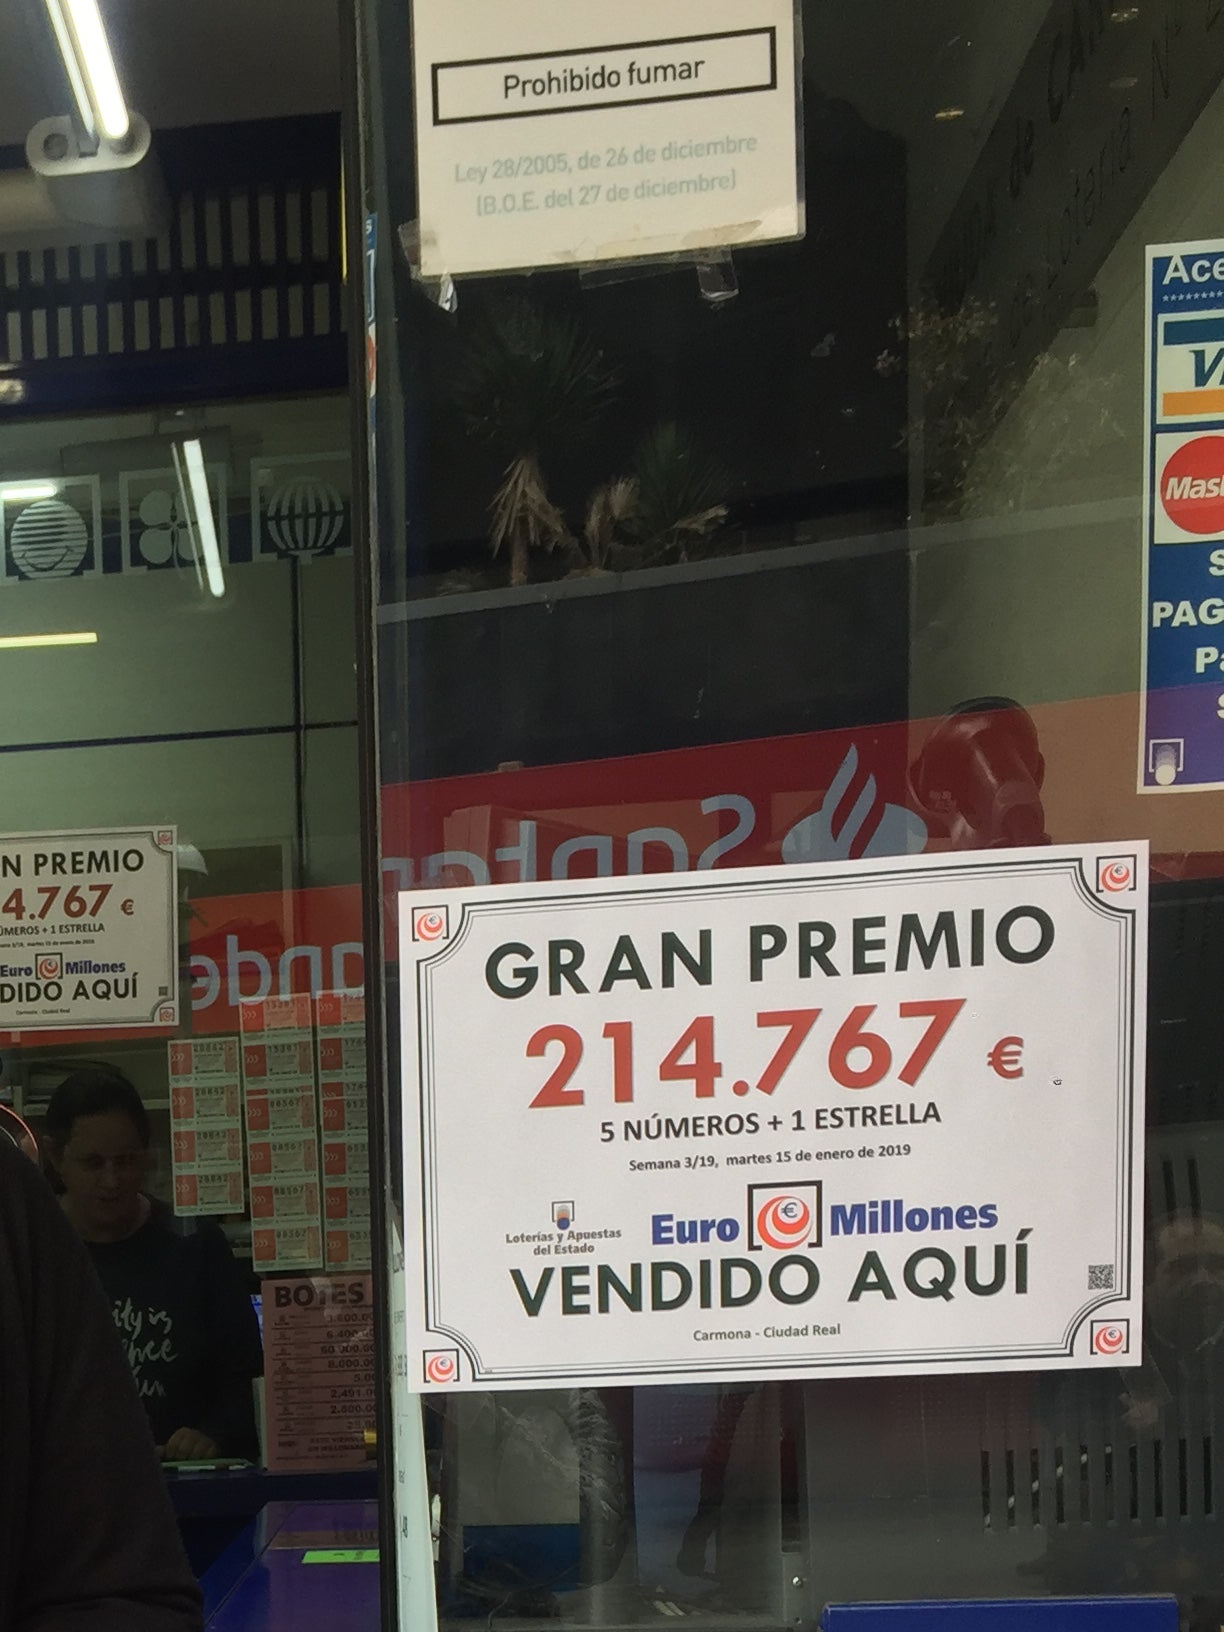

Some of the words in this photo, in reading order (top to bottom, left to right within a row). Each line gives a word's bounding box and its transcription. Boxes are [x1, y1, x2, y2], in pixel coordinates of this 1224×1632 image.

[504, 65, 620, 98] Prohibido
[628, 61, 705, 85] fumar
[454, 163, 486, 184] Ley
[492, 153, 572, 179] 28/2005,
[578, 150, 602, 171] de
[606, 147, 628, 167] 26
[634, 144, 655, 165] de
[661, 135, 758, 161] diciembre
[477, 193, 539, 217] (B.O.E.
[545, 187, 573, 209] del
[579, 185, 601, 205] 27
[606, 182, 629, 202] de
[634, 168, 736, 199] diciembre)
[34, 849, 144, 876] PREMIO
[59, 923, 105, 933] ESTRELLA
[485, 929, 712, 999] GRAN
[750, 906, 1054, 982] PREMIO
[0, 965, 33, 977] Euro
[66, 960, 126, 974] Millones
[72, 972, 138, 1000] AQUÍ
[526, 998, 967, 1108] 214.767
[987, 1036, 1023, 1079] €
[601, 1122, 614, 1142] 5
[624, 1113, 759, 1141] NÚMEROS
[792, 1110, 805, 1131] 1
[816, 1102, 941, 1129] ESTRELLA
[630, 1160, 680, 1171] Semana
[685, 1155, 718, 1169] 3/19,
[727, 1154, 772, 1165] martes
[777, 1151, 791, 1162] 15
[795, 1150, 811, 1161] de
[816, 1150, 854, 1160] enero
[858, 1146, 874, 1158] de
[879, 1144, 911, 1156] 2019
[652, 1214, 739, 1245] Euro
[831, 1199, 998, 1236] Millones
[506, 1232, 553, 1243] Loterías
[557, 1233, 563, 1244] y
[567, 1229, 621, 1242] Apuestas
[534, 1245, 550, 1255] del
[555, 1243, 594, 1254] Estado
[510, 1255, 820, 1317] VENDIDO
[848, 1226, 1034, 1302] AQUÍ
[274, 1281, 364, 1308] BOTES
[694, 1330, 751, 1341] Carmona
[764, 1325, 808, 1338] Ciudad
[813, 1323, 840, 1335] Real
